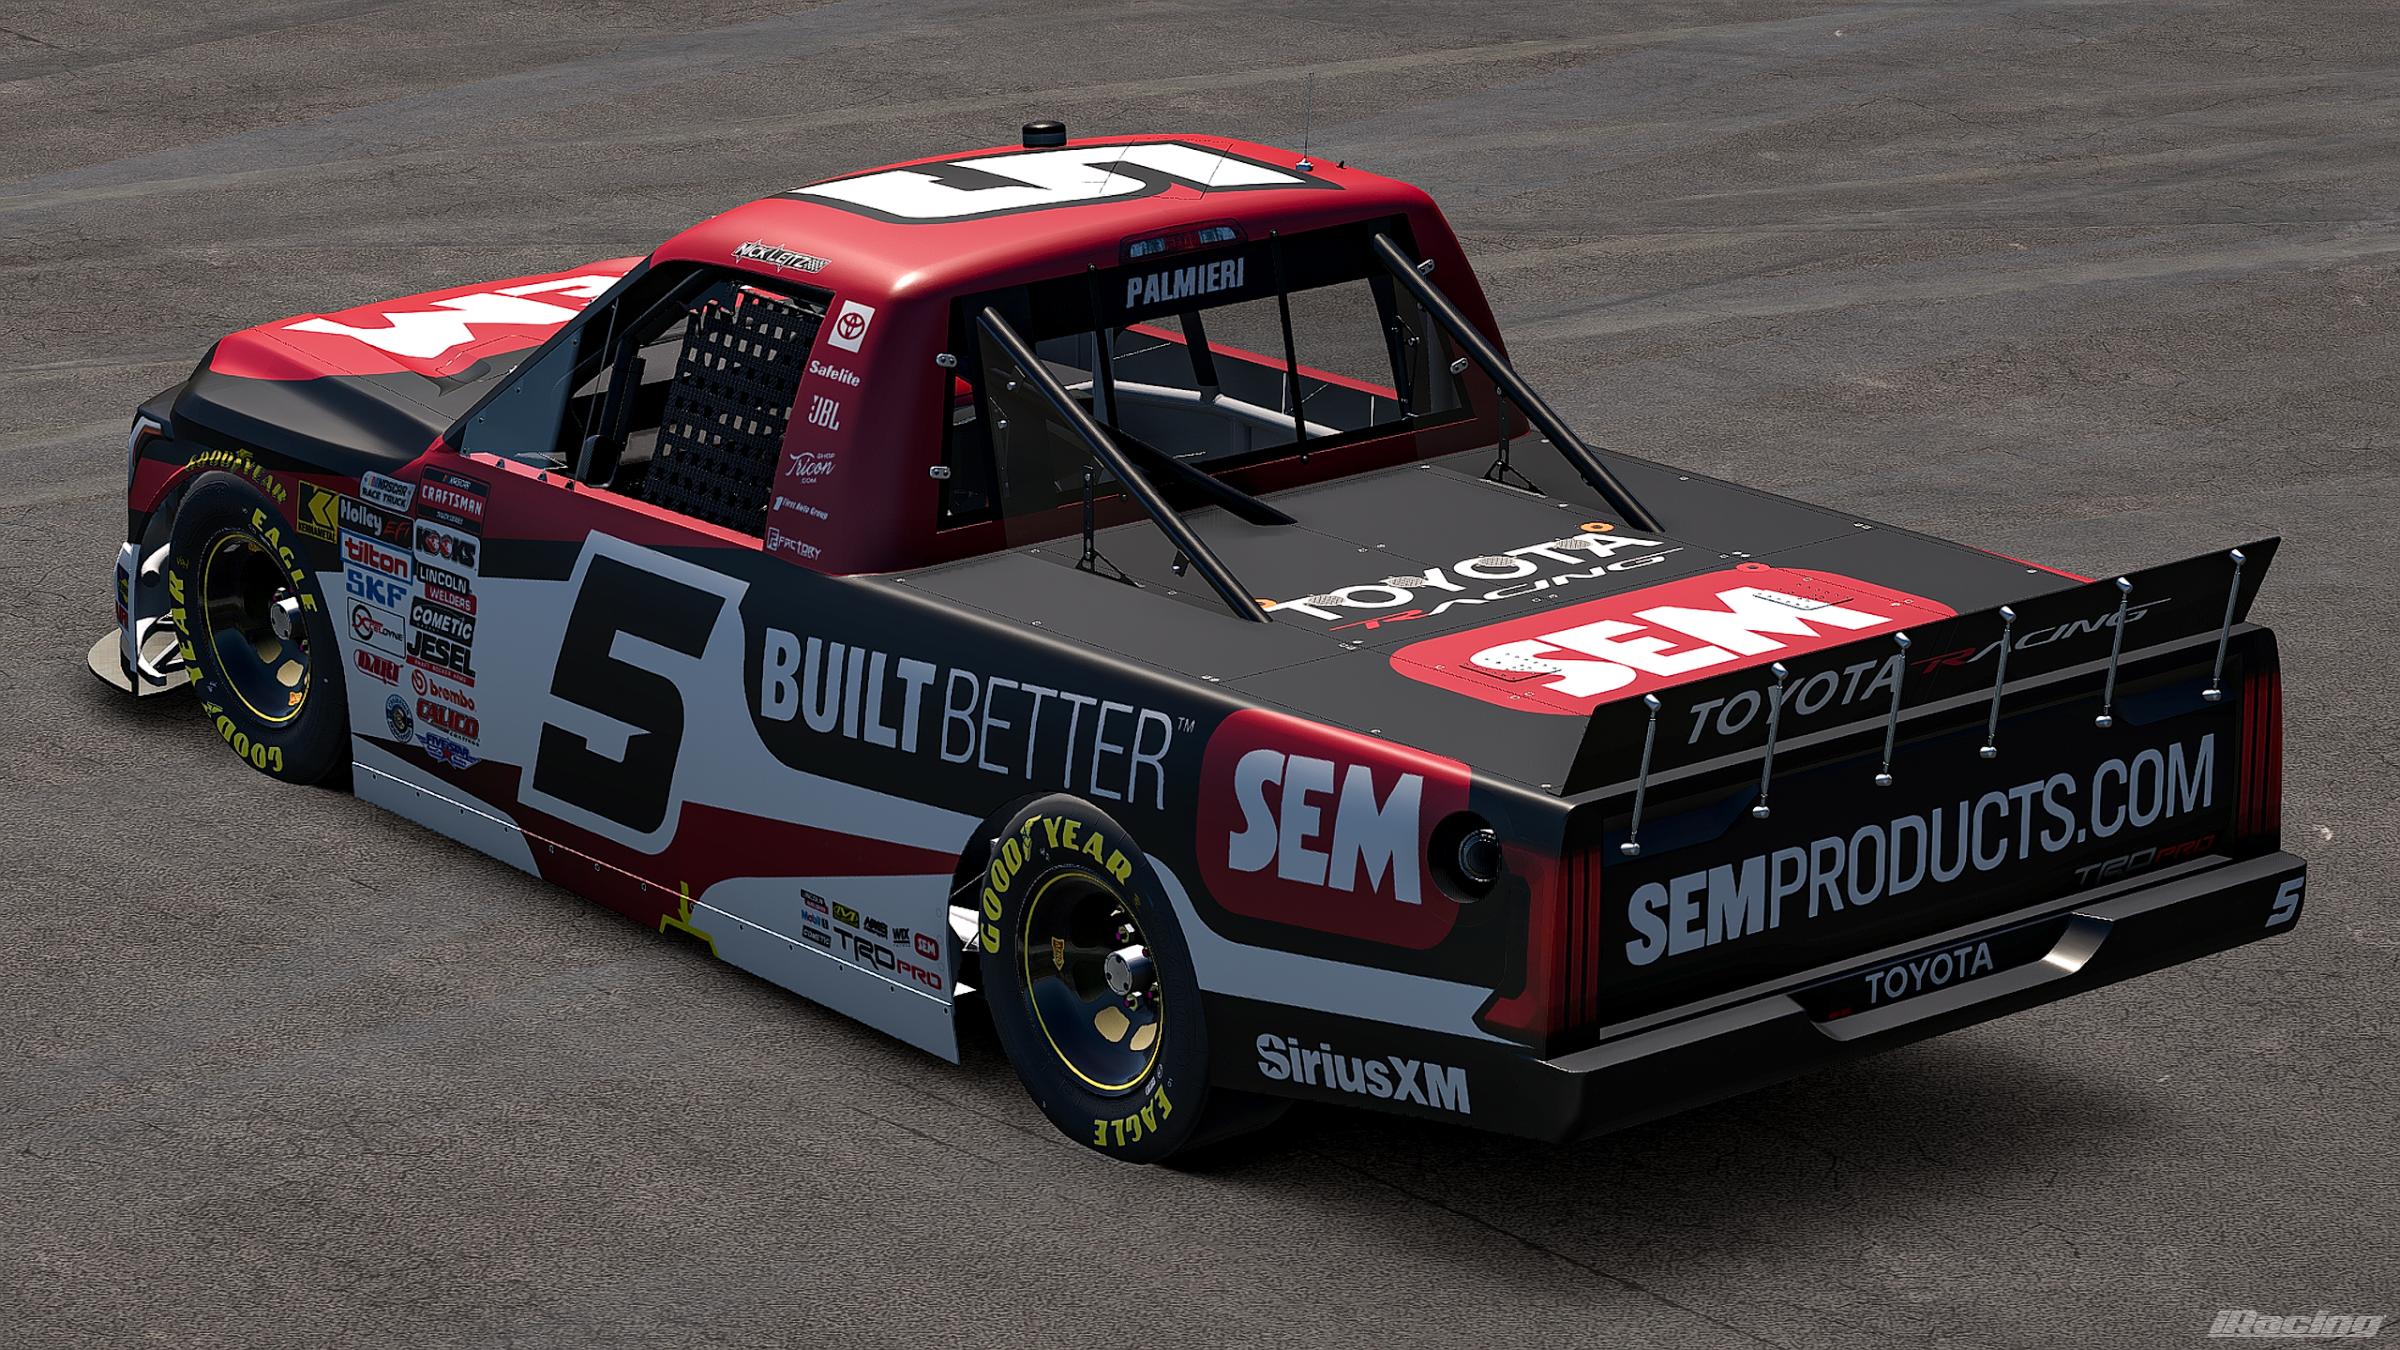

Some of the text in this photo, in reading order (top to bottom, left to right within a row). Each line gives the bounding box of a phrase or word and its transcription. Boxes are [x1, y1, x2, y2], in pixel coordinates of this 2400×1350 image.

[786, 143, 1306, 219] 5
[734, 242, 809, 268] NICK LEITZ
[1126, 257, 1245, 309] PALMIERI
[809, 359, 861, 387] Safelite
[808, 394, 840, 431] JBL
[785, 452, 837, 476] Tricon
[362, 487, 407, 508] RACE TRUCK
[376, 477, 408, 497] NASCAR
[421, 485, 483, 516] CRAFTSMAN
[341, 499, 383, 536] Holley
[252, 508, 317, 613] EAGLE
[345, 537, 408, 578] tilton
[416, 524, 477, 568] KOOKS
[778, 536, 822, 561] FACTORY
[346, 569, 407, 608] SKF
[420, 567, 467, 594] LINCOLN
[1268, 532, 1664, 621] TOYOTA
[1328, 547, 1685, 631] RACING
[429, 586, 472, 611] WELDERS
[412, 605, 473, 640] COMETIC
[1470, 586, 1894, 698] SEM
[407, 631, 476, 678] JESEL
[1687, 598, 2172, 745] TOYOTA RACING
[429, 678, 475, 712] brembo
[533, 553, 727, 834] 5
[416, 698, 480, 740] CALICO
[760, 627, 937, 753] BUILT
[940, 668, 1173, 810] BETTER
[1229, 749, 1424, 905] SEM
[1625, 733, 2215, 967] SEMPRODUCTS.COM
[2075, 833, 2219, 886] TRD PRO
[801, 909, 821, 926] Mobil
[2264, 875, 2306, 929] 5
[803, 928, 830, 946] COMETIC
[892, 927, 910, 940] WIX
[917, 939, 937, 957] SEM
[833, 926, 896, 970] TRD
[896, 959, 942, 990] PRO
[1865, 942, 1994, 1004] TOYOTA
[1256, 1032, 1471, 1114] SiriusXM
[1093, 1084, 1173, 1147] EAGLE
